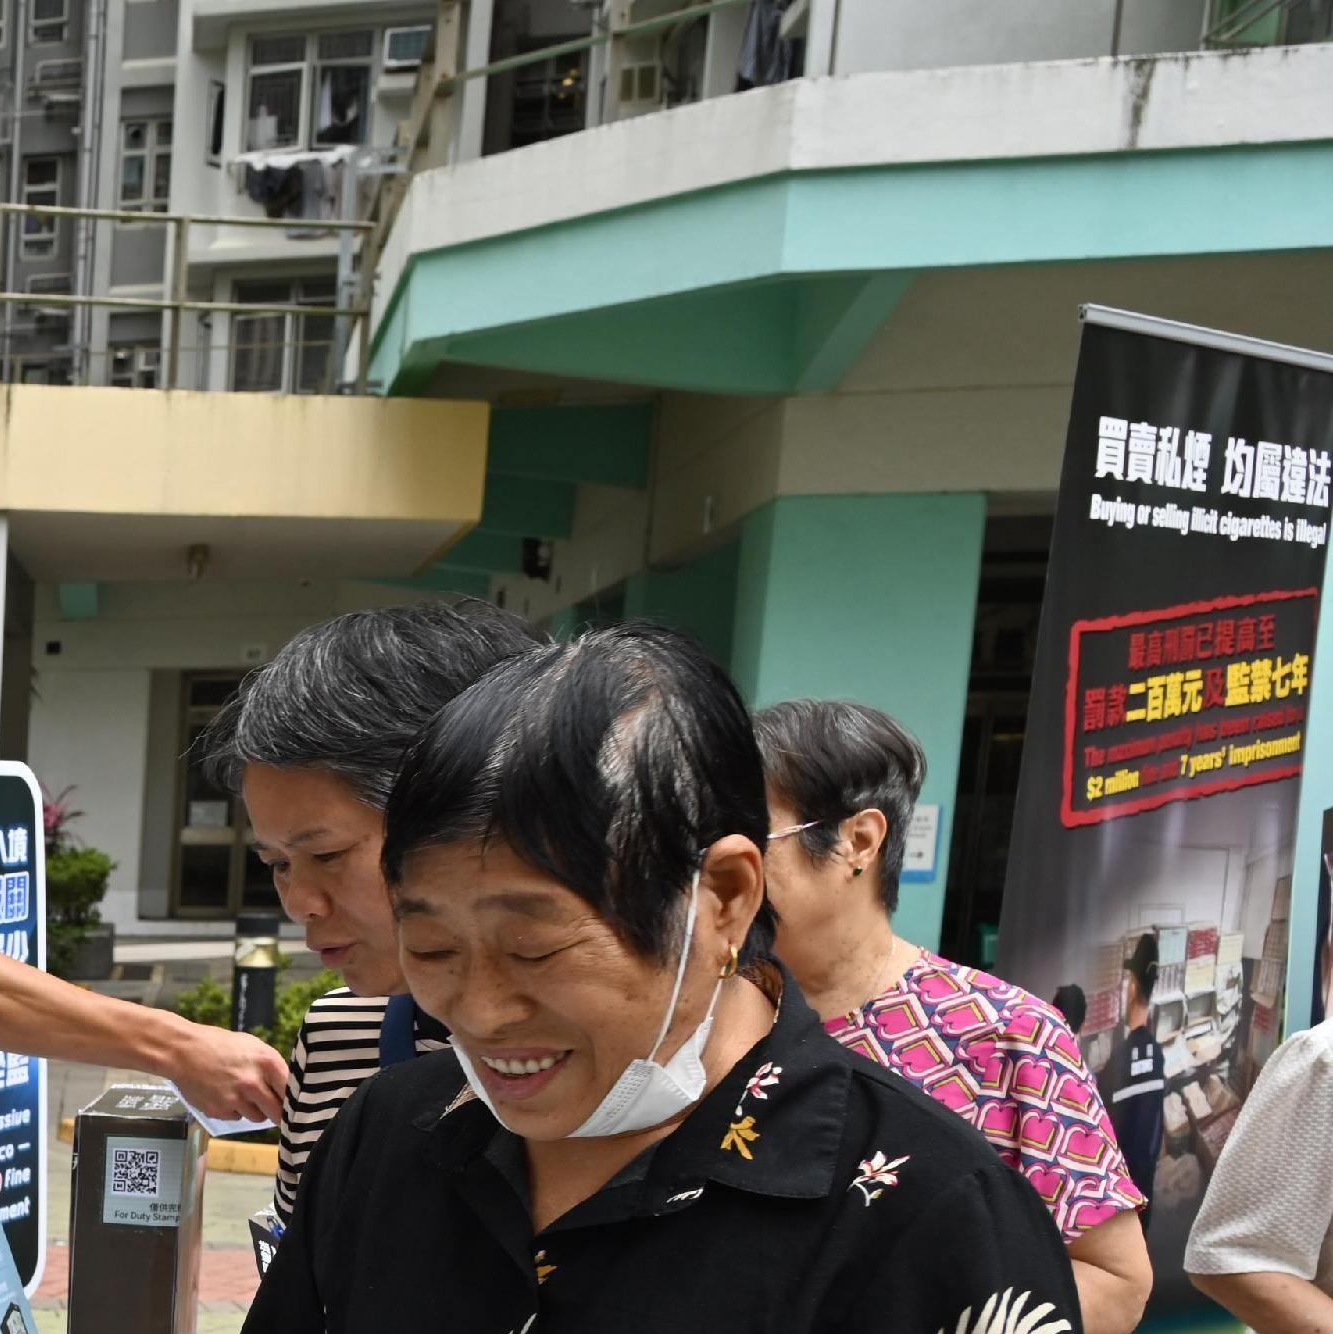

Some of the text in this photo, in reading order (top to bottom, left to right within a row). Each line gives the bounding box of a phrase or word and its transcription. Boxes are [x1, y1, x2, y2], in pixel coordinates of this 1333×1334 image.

[1094, 416, 1332, 507] 買賣私煙 均屬違法
[1089, 493, 1327, 549] Buying or selling illicit cigarettes is illegal
[1128, 614, 1276, 670] 最高刑罰已提高至
[1084, 652, 1309, 731] 罰款二百萬元及監禁七年
[1085, 745, 1106, 768] The
[1158, 726, 1193, 756] penalty
[1196, 723, 1218, 742] has
[1220, 716, 1250, 740] been
[1253, 709, 1284, 734] raised
[1086, 776, 1104, 801] $2
[1104, 768, 1139, 795] million
[1180, 754, 1188, 775] 7
[1228, 730, 1301, 768] imprisonment
[115, 1210, 181, 1223] For Duty Stamp
